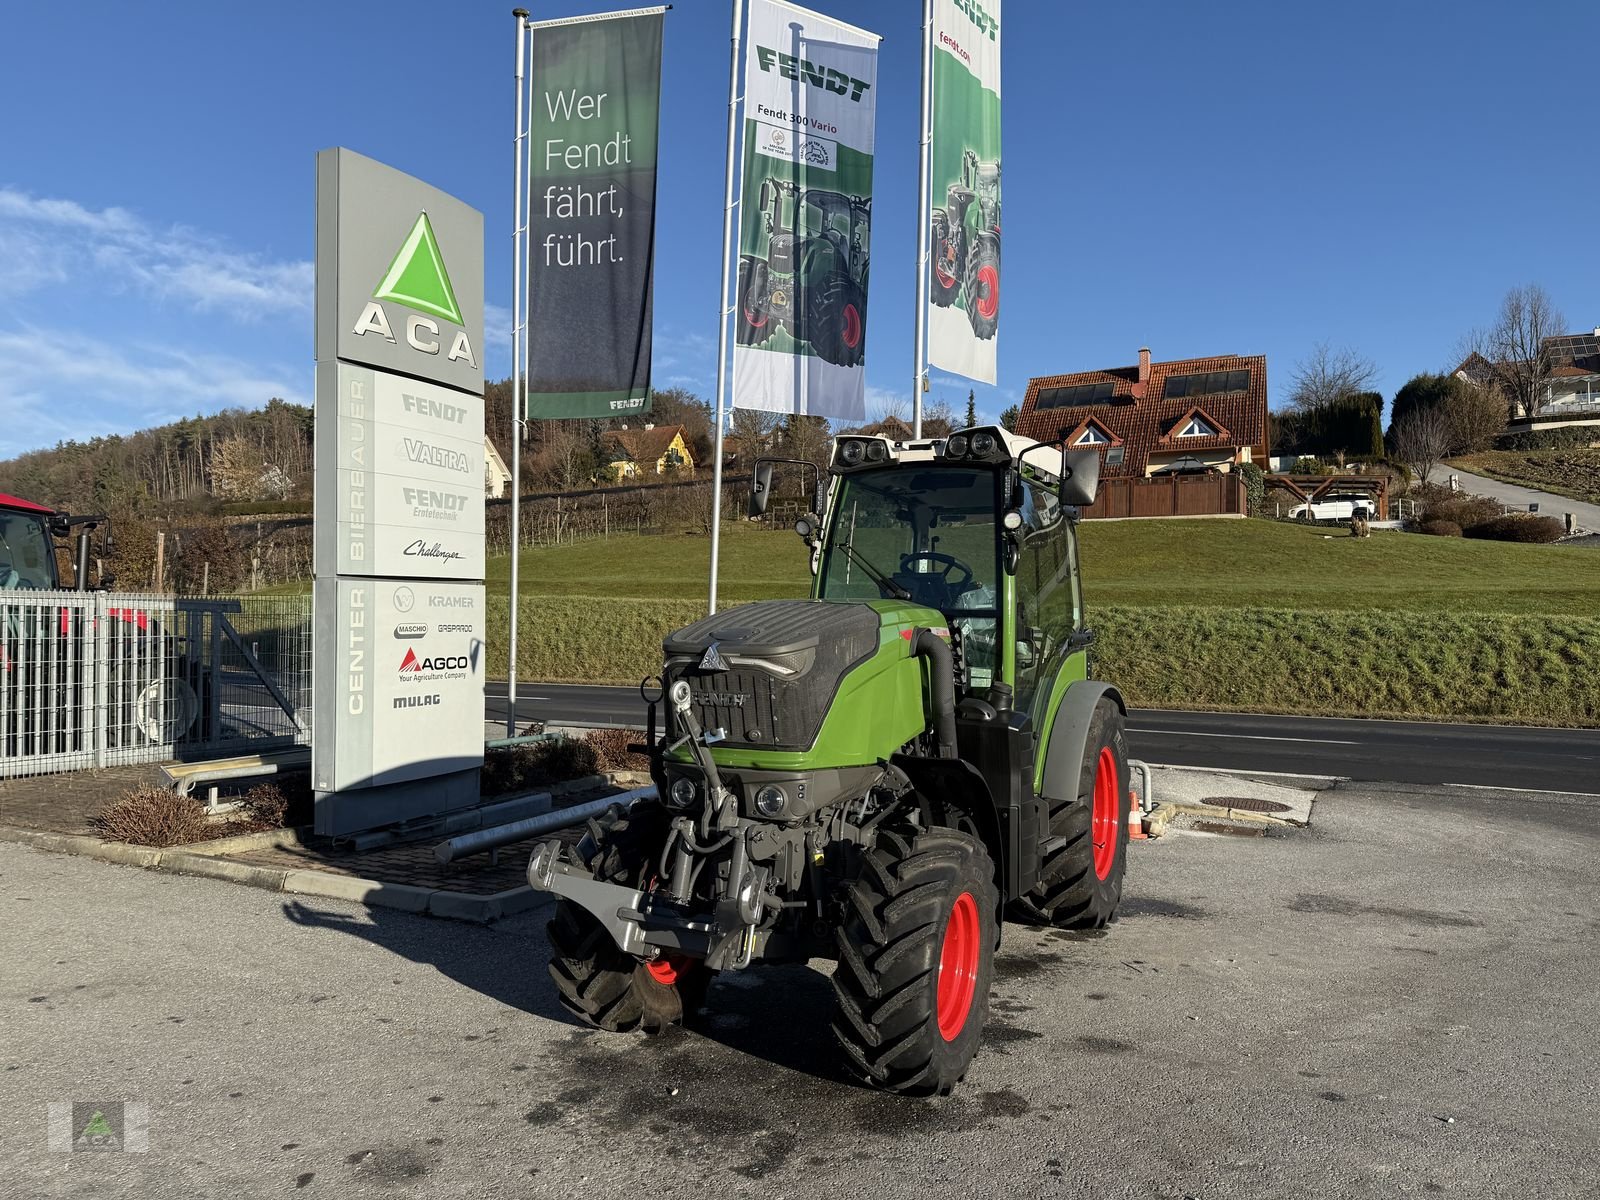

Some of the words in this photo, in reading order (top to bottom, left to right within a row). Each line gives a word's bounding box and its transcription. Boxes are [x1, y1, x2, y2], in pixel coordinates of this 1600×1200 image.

[756, 45, 871, 103] FENDT
[545, 89, 607, 122] Wer
[757, 104, 787, 121] Fendt
[789, 113, 808, 126] 300
[810, 118, 837, 134] Vario
[546, 131, 632, 171] Fendt
[544, 184, 623, 218] fährt,
[543, 232, 623, 266] führt.
[352, 301, 478, 369] ACA
[402, 393, 468, 424] FENDT
[610, 398, 645, 410] FENDT
[403, 437, 469, 473] VALTRA
[402, 487, 469, 512] FENDT
[403, 540, 467, 565] Challenger
[428, 595, 474, 608] KRAMER
[398, 625, 427, 633] MASCHIO
[437, 624, 473, 633] GASPARDO
[349, 588, 365, 715] CENTER
[421, 656, 468, 671] AGCO
[399, 674, 413, 683] Your
[413, 672, 444, 683] Agriculture
[444, 671, 467, 680] Company
